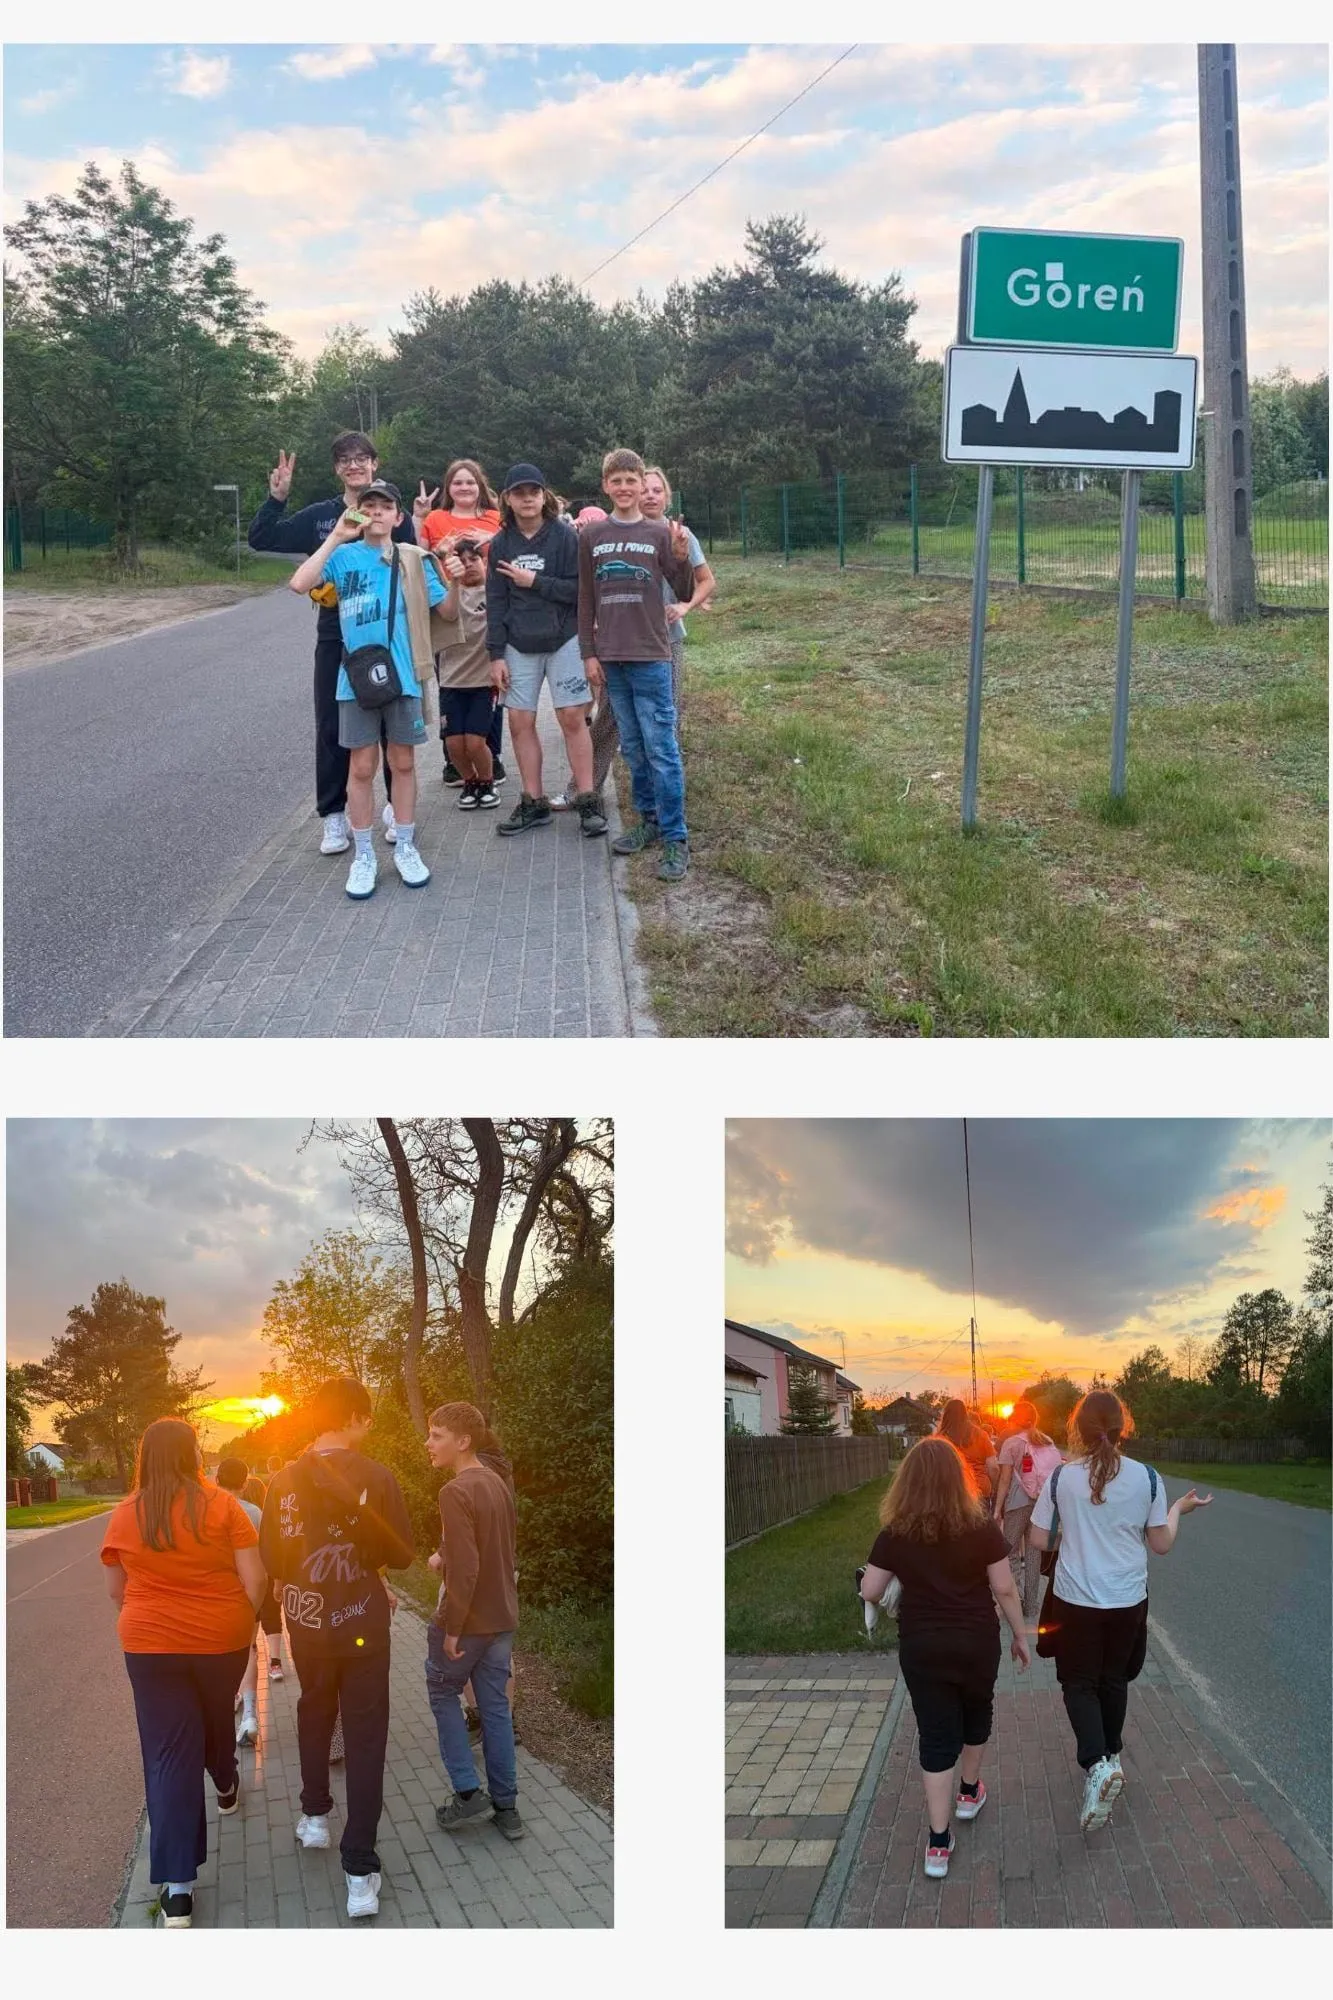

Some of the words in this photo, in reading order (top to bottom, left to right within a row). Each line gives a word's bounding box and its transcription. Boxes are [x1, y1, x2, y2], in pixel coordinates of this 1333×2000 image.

[592, 543, 615, 557] SPEED
[624, 542, 655, 554] POWER
[283, 1584, 324, 1629] 02
